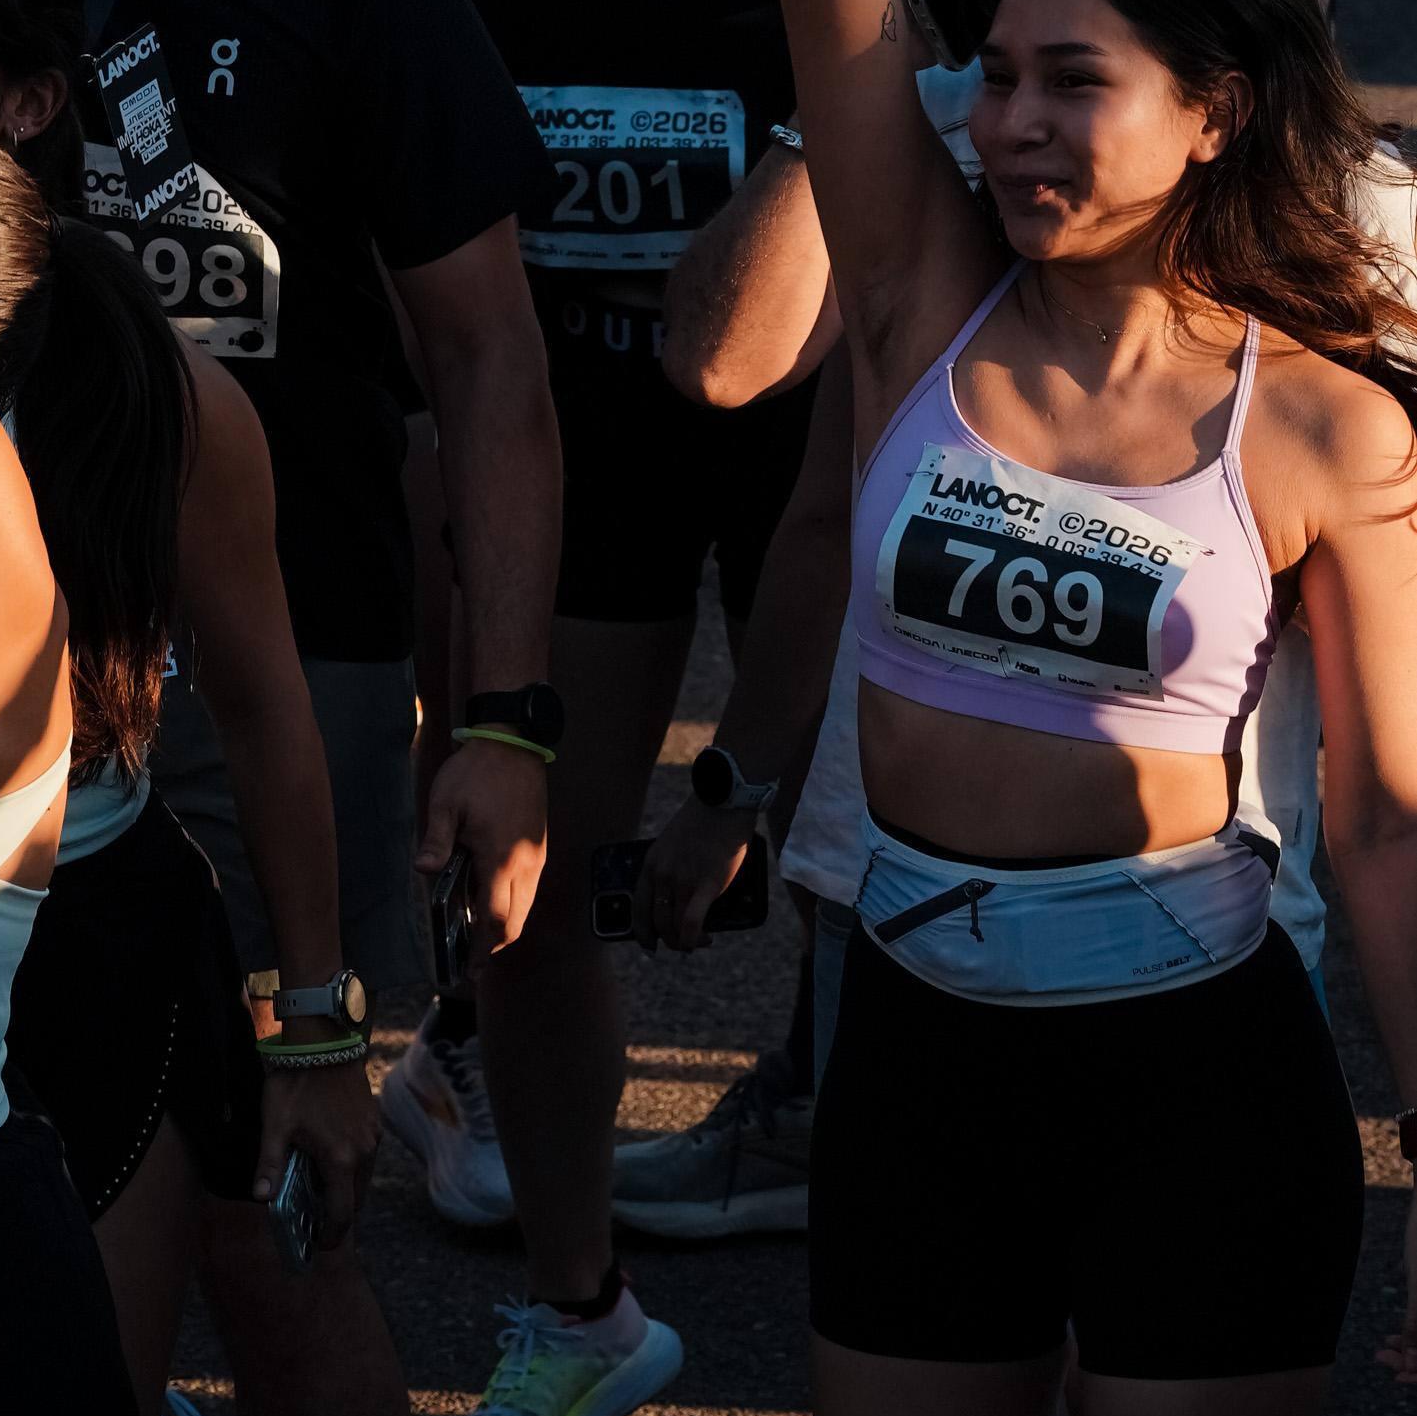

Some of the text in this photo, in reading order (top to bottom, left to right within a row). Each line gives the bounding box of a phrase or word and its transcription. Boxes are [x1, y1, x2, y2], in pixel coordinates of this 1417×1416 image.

[98, 31, 160, 89] LANOCT.
[535, 109, 727, 134] ANOCT. ©2026
[135, 163, 198, 222] LANOCT.
[551, 159, 686, 225] 201
[105, 231, 248, 308] 98
[921, 502, 935, 516] N
[929, 473, 1172, 567] LANOCT. ©2026
[944, 537, 1104, 648] 769
[1132, 954, 1191, 975] PULSE BELT
